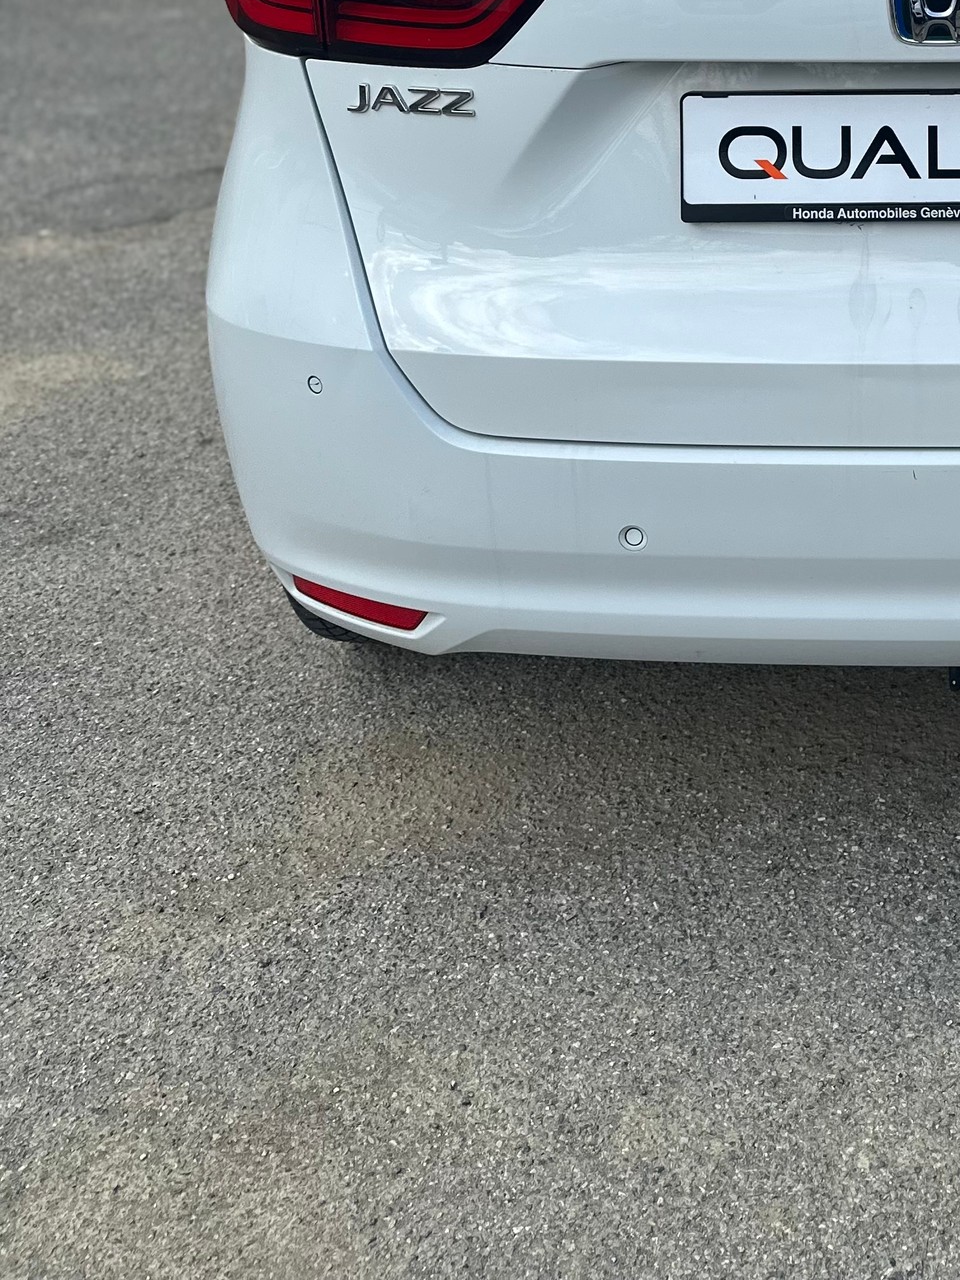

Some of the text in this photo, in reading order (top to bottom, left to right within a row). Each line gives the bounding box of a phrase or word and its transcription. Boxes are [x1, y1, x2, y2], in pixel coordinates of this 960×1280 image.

[347, 82, 477, 118] JAZZ
[792, 207, 834, 219] Honda
[837, 206, 917, 219] Automobiles
